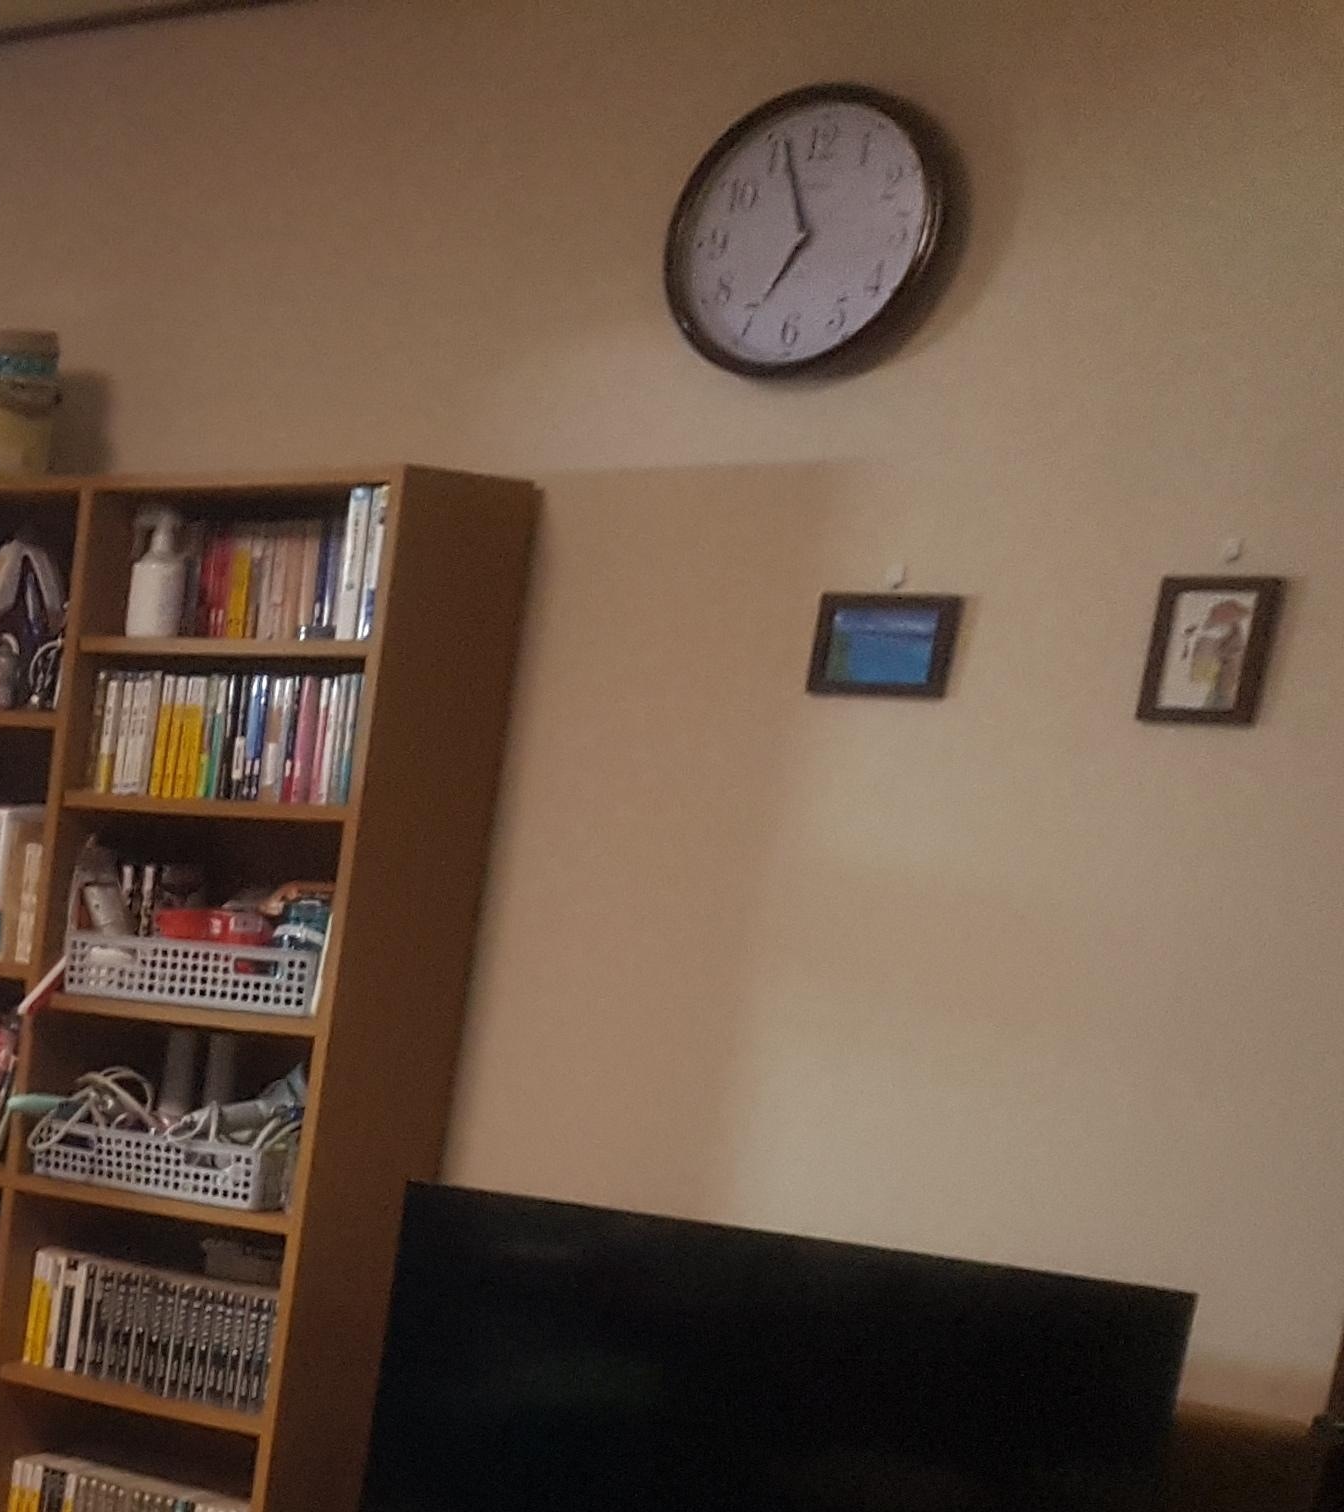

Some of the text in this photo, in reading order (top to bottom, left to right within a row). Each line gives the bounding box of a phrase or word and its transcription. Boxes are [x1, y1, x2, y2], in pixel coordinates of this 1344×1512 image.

[807, 122, 840, 162] 12
[860, 130, 872, 168] 1
[728, 176, 761, 214] 10
[880, 164, 905, 202] 2
[864, 259, 886, 298] 4
[740, 301, 763, 338] 7
[779, 311, 803, 348] 6
[824, 292, 851, 334] 5
